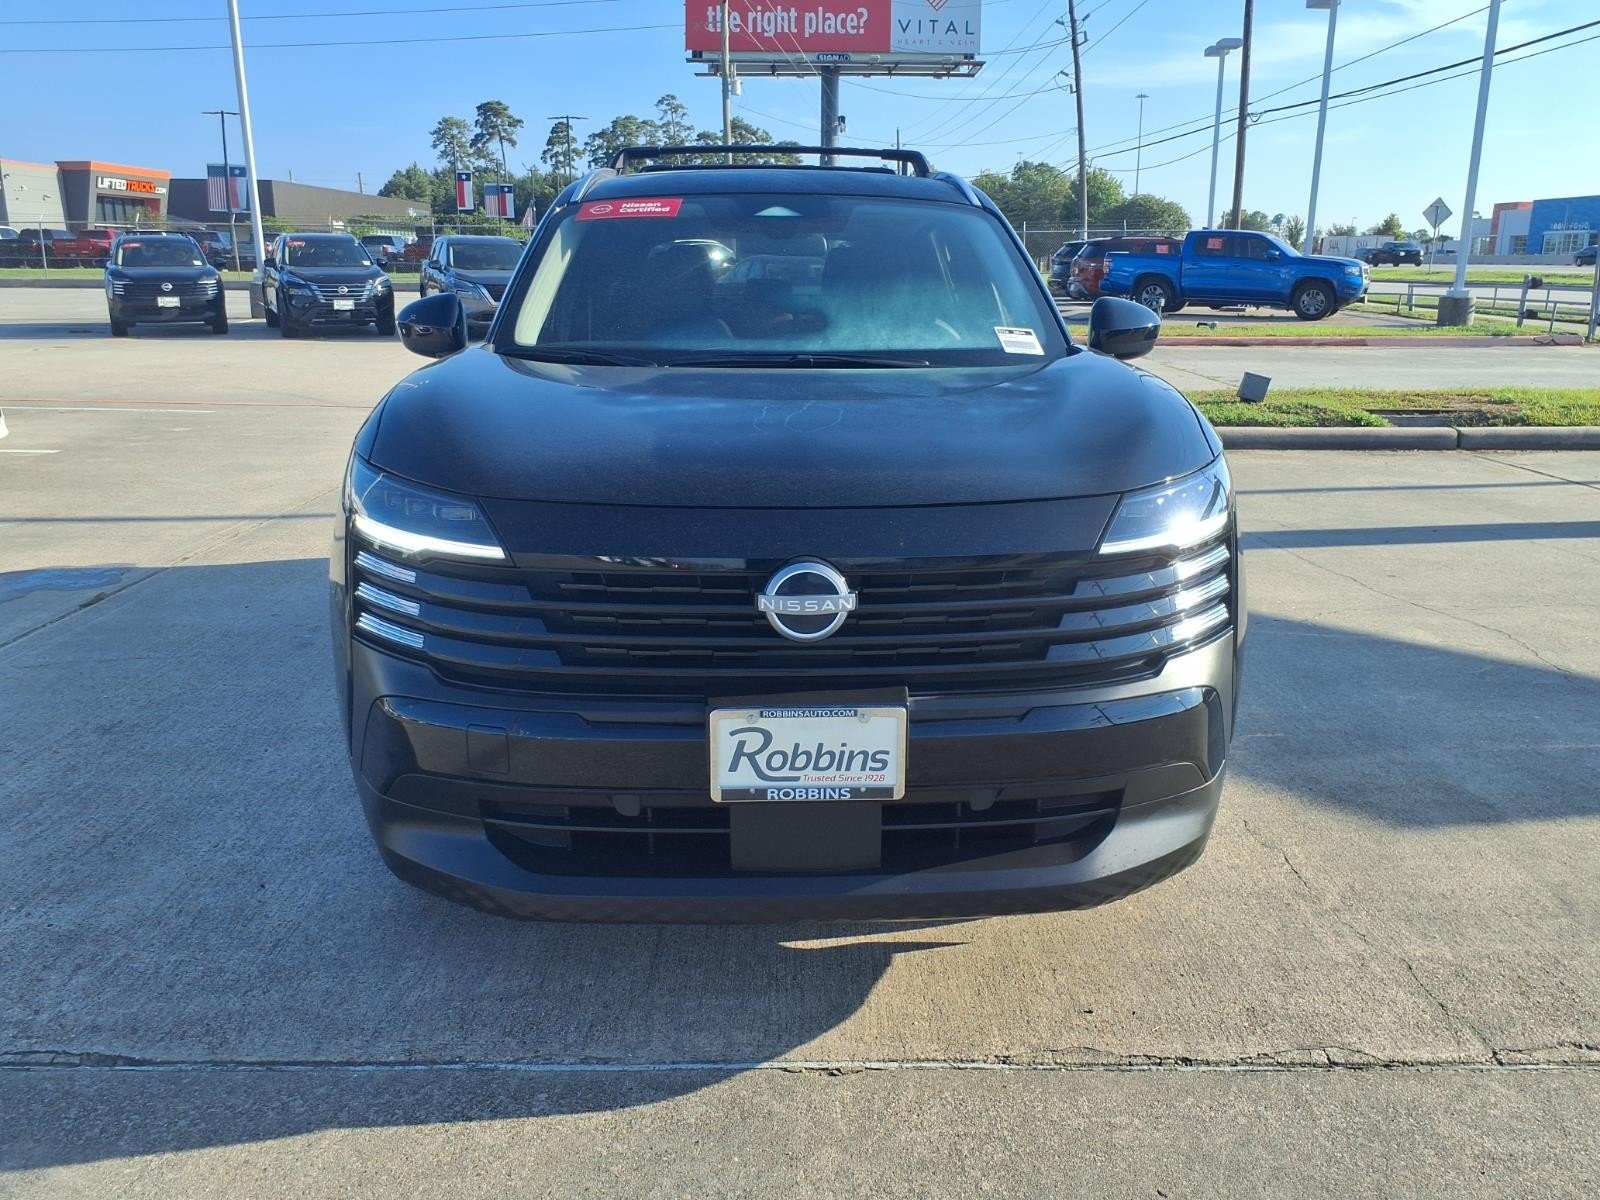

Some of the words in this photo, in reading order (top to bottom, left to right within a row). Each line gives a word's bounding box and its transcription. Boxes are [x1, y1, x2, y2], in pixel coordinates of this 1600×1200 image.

[747, 5, 798, 37] right
[804, 6, 869, 38] place?
[897, 18, 976, 35] VITAL
[760, 597, 853, 612] NISSAN
[762, 709, 855, 718] ROBBINSAUTO.COM
[728, 726, 890, 782] Robbins
[803, 774, 836, 783] Trusted
[838, 774, 863, 783] Since
[864, 774, 886, 782] 1928
[767, 787, 851, 800] ROBBINS
